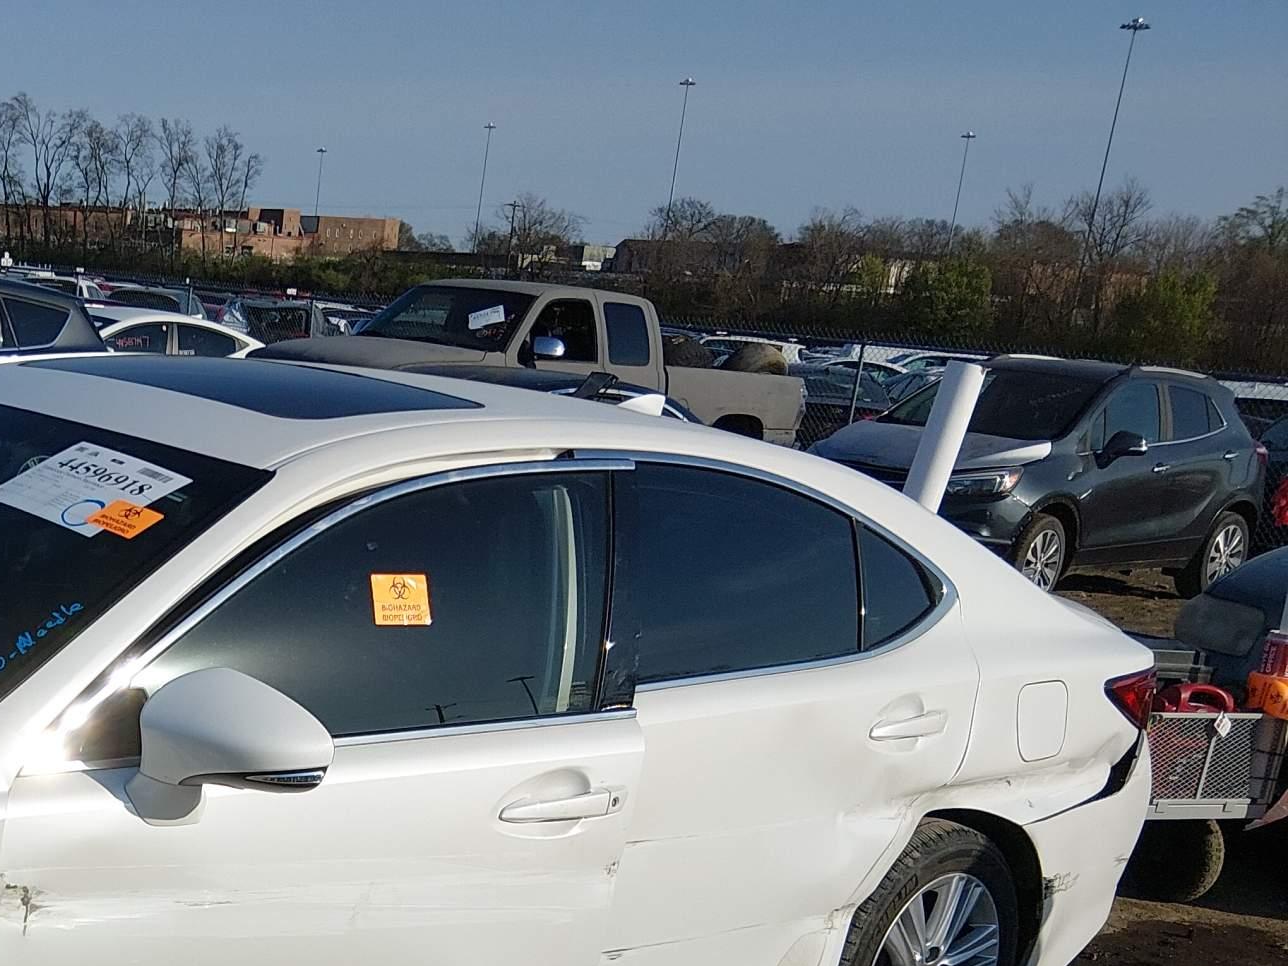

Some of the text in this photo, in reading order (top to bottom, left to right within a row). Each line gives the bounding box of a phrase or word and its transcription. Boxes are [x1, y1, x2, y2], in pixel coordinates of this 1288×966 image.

[58, 457, 153, 496] 44596918
[100, 513, 137, 530] BIOHAZARD
[381, 603, 422, 612] BIOHAZARD
